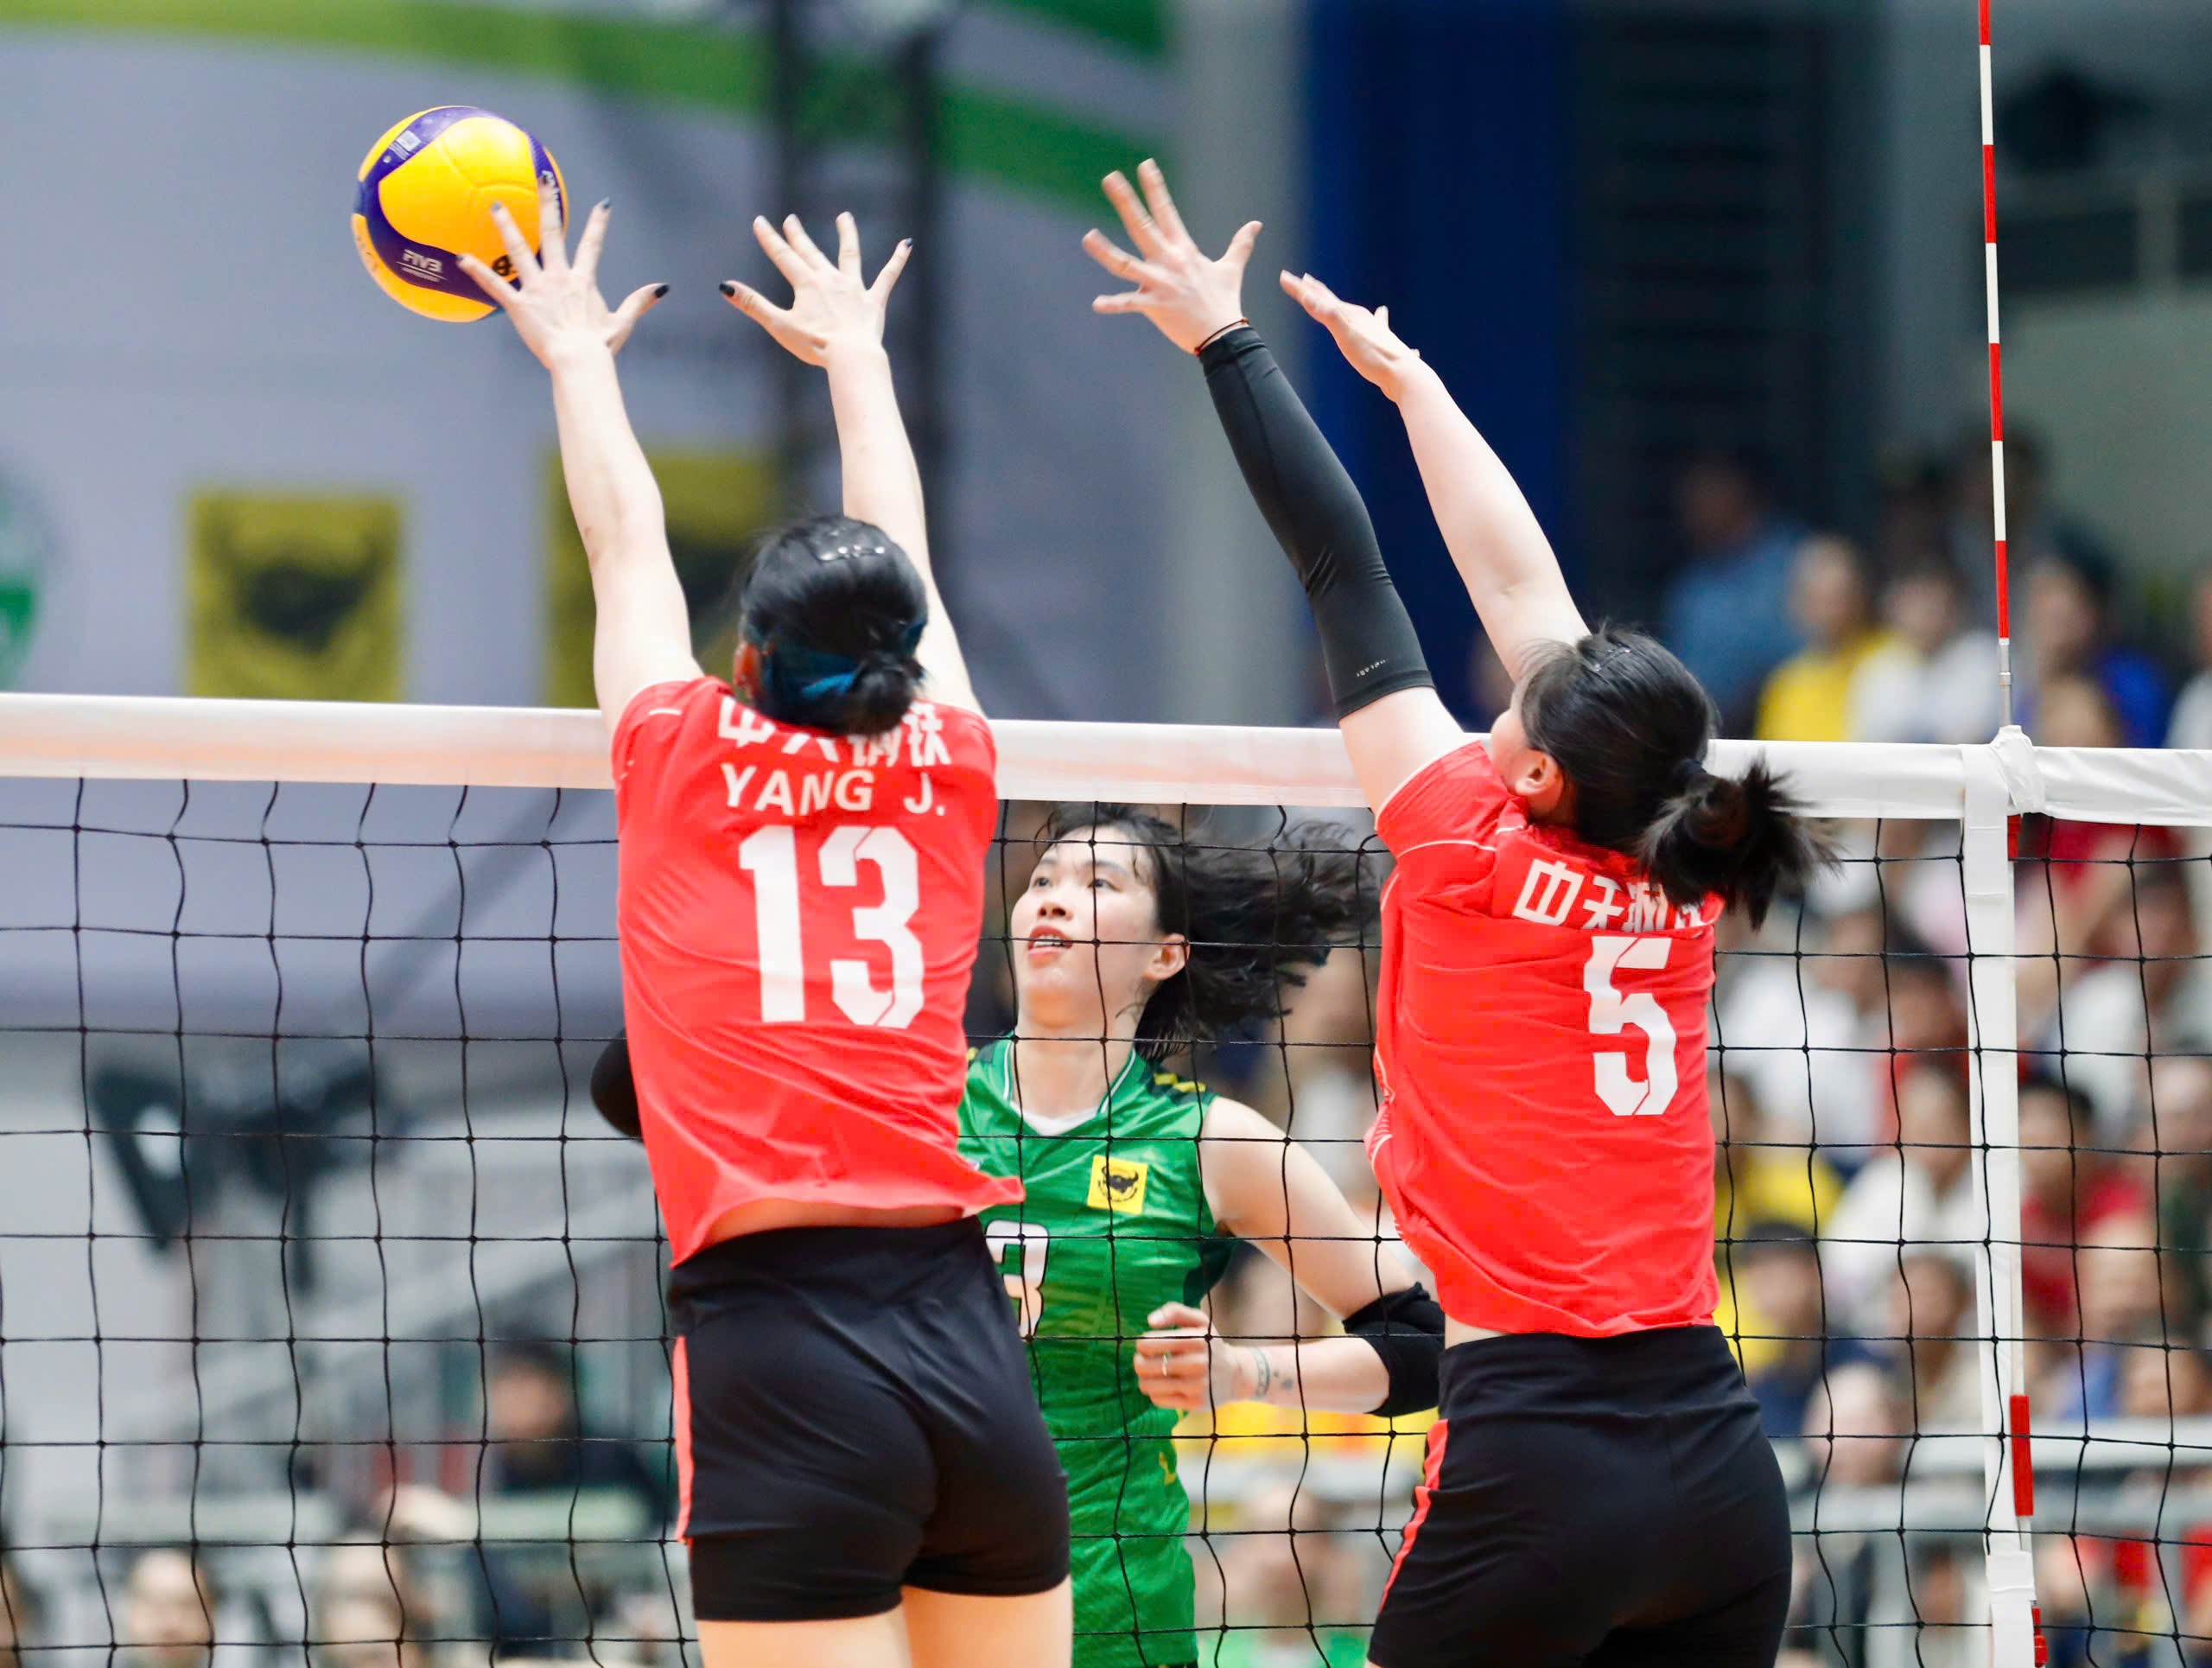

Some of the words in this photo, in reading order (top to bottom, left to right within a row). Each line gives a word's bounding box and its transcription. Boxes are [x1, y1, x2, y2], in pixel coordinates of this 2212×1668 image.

[720, 763, 874, 816] YANG
[903, 773, 945, 816] J.
[739, 824, 924, 1029] 13
[1583, 936, 1678, 1117] 5
